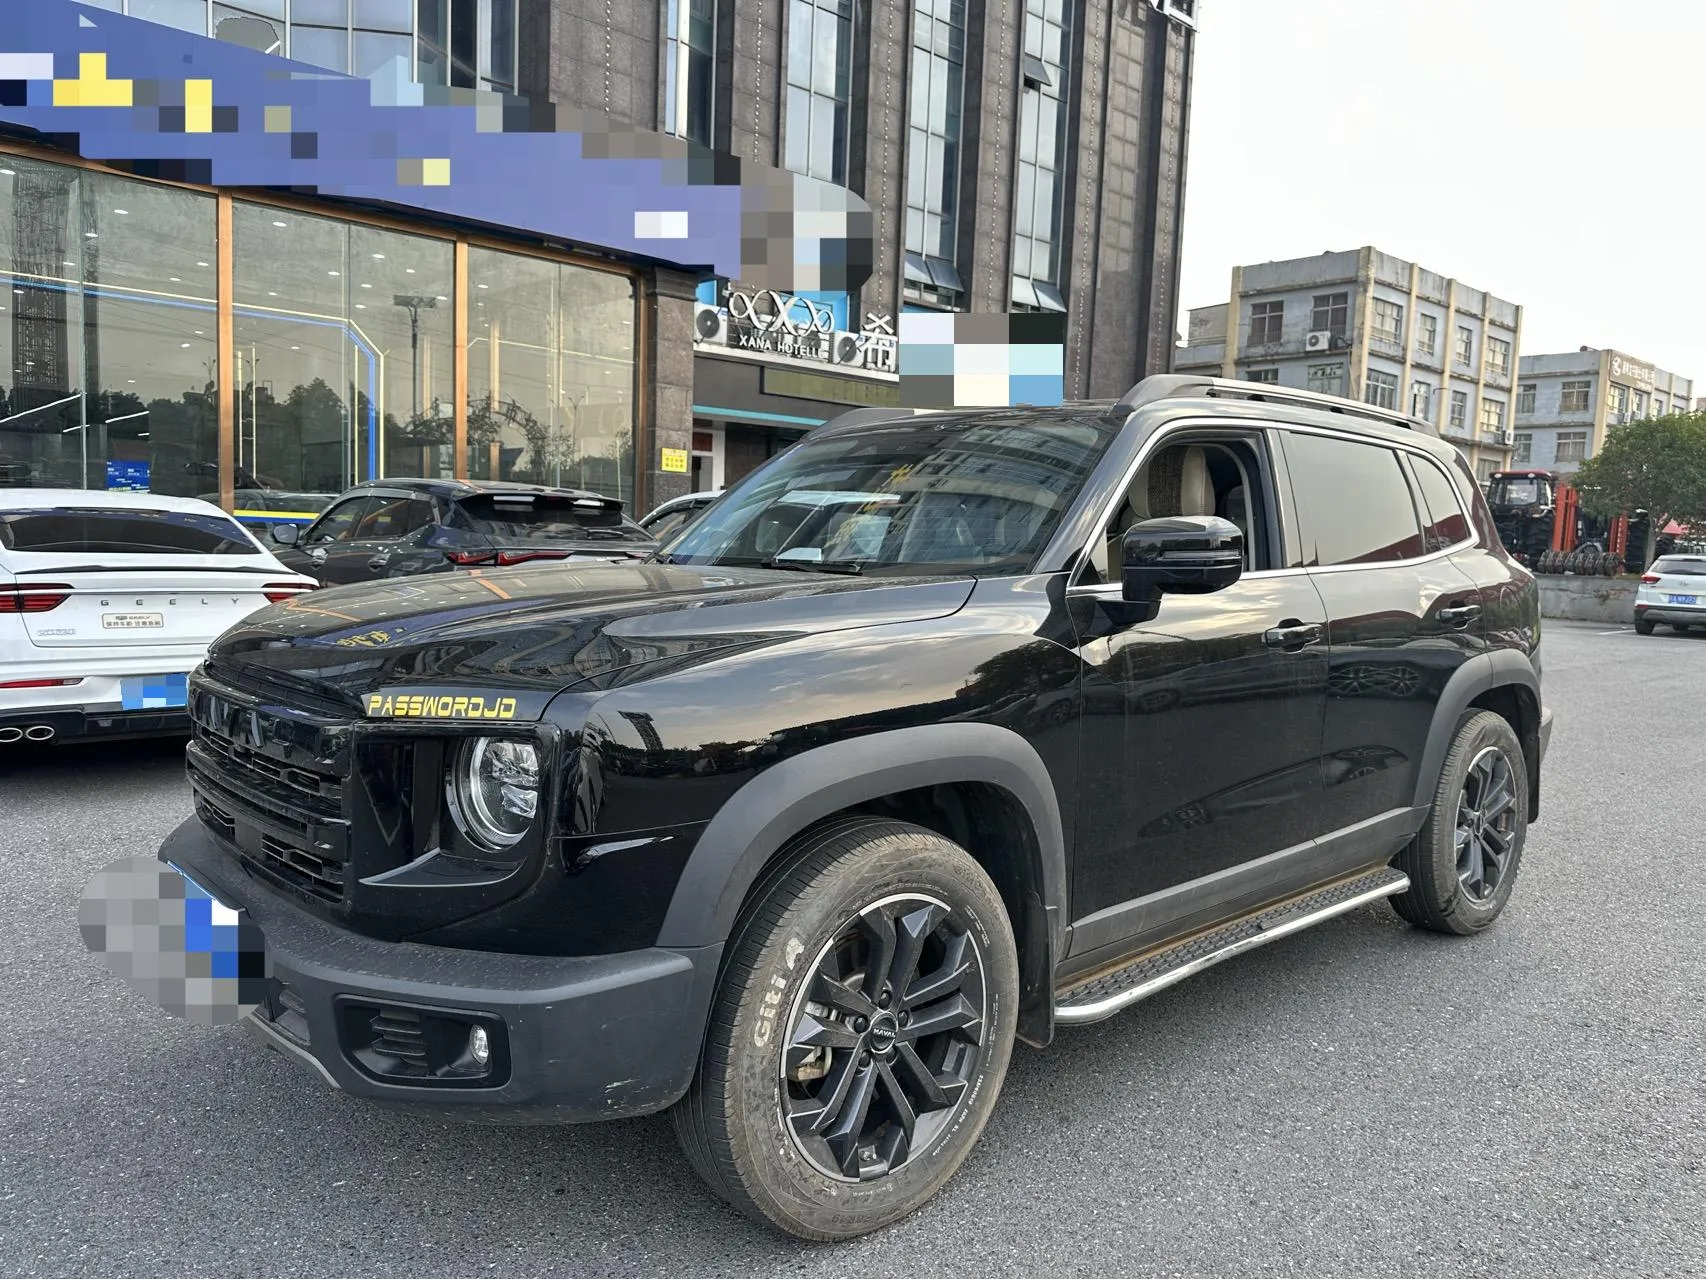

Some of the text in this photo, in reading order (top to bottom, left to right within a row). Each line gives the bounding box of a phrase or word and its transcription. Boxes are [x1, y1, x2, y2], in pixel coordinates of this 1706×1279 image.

[739, 334, 772, 350] XANA
[100, 598, 239, 606] GEELY
[367, 695, 517, 719] PASSWORDJD
[873, 1028, 896, 1038] HAVAL
